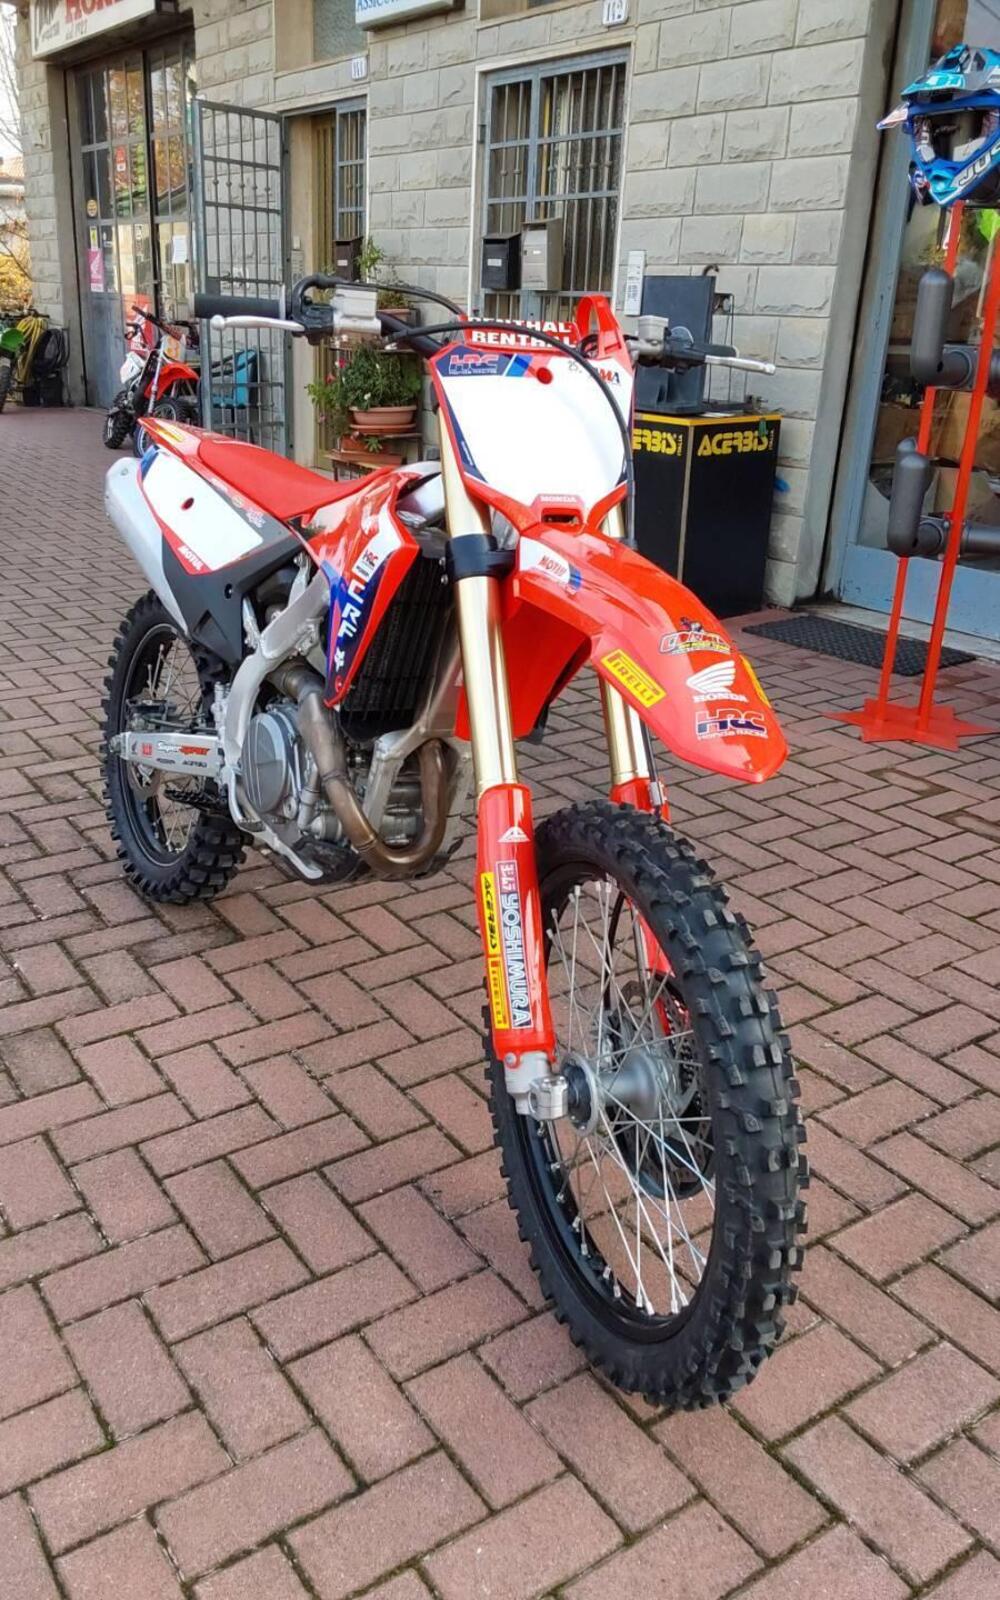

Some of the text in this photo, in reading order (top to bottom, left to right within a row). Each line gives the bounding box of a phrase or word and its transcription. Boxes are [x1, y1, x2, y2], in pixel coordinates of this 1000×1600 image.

[468, 316, 571, 333] THAL
[472, 330, 577, 348] RENTHL
[632, 428, 677, 456] ERBIS
[606, 652, 660, 702] PIRELLI
[501, 893, 531, 1027] YOSHIMURA
